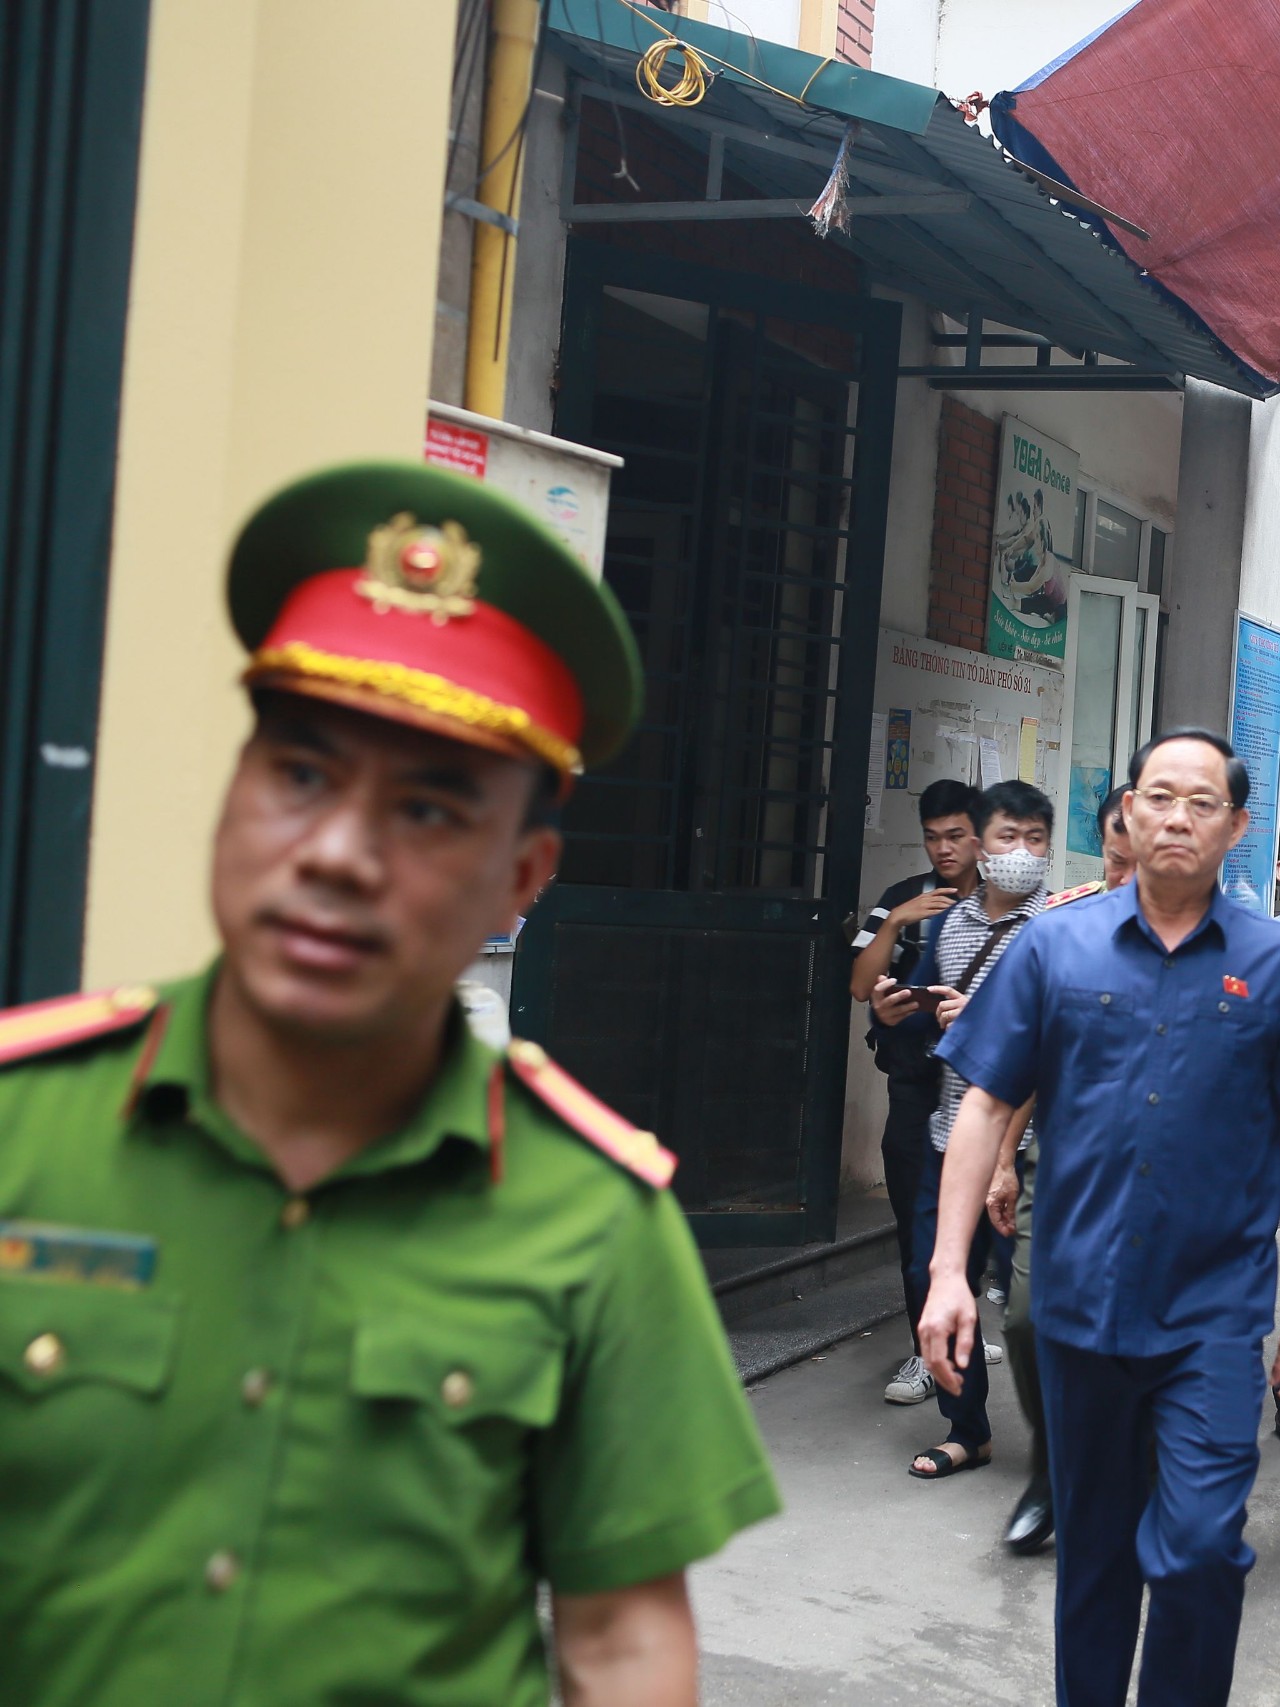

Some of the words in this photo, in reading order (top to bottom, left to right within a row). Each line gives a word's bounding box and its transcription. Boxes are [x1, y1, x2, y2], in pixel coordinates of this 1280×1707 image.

[1013, 434, 1042, 481] YOGA
[1043, 457, 1071, 495] Dance
[892, 638, 918, 668] BẢNG
[920, 650, 949, 675] THÔNG
[951, 659, 965, 680] TIN
[967, 656, 978, 682] TỔ
[979, 663, 996, 686] DÂN
[997, 666, 1013, 690] PHỐ
[1013, 669, 1023, 692] SỐ
[1024, 678, 1032, 694] 31
